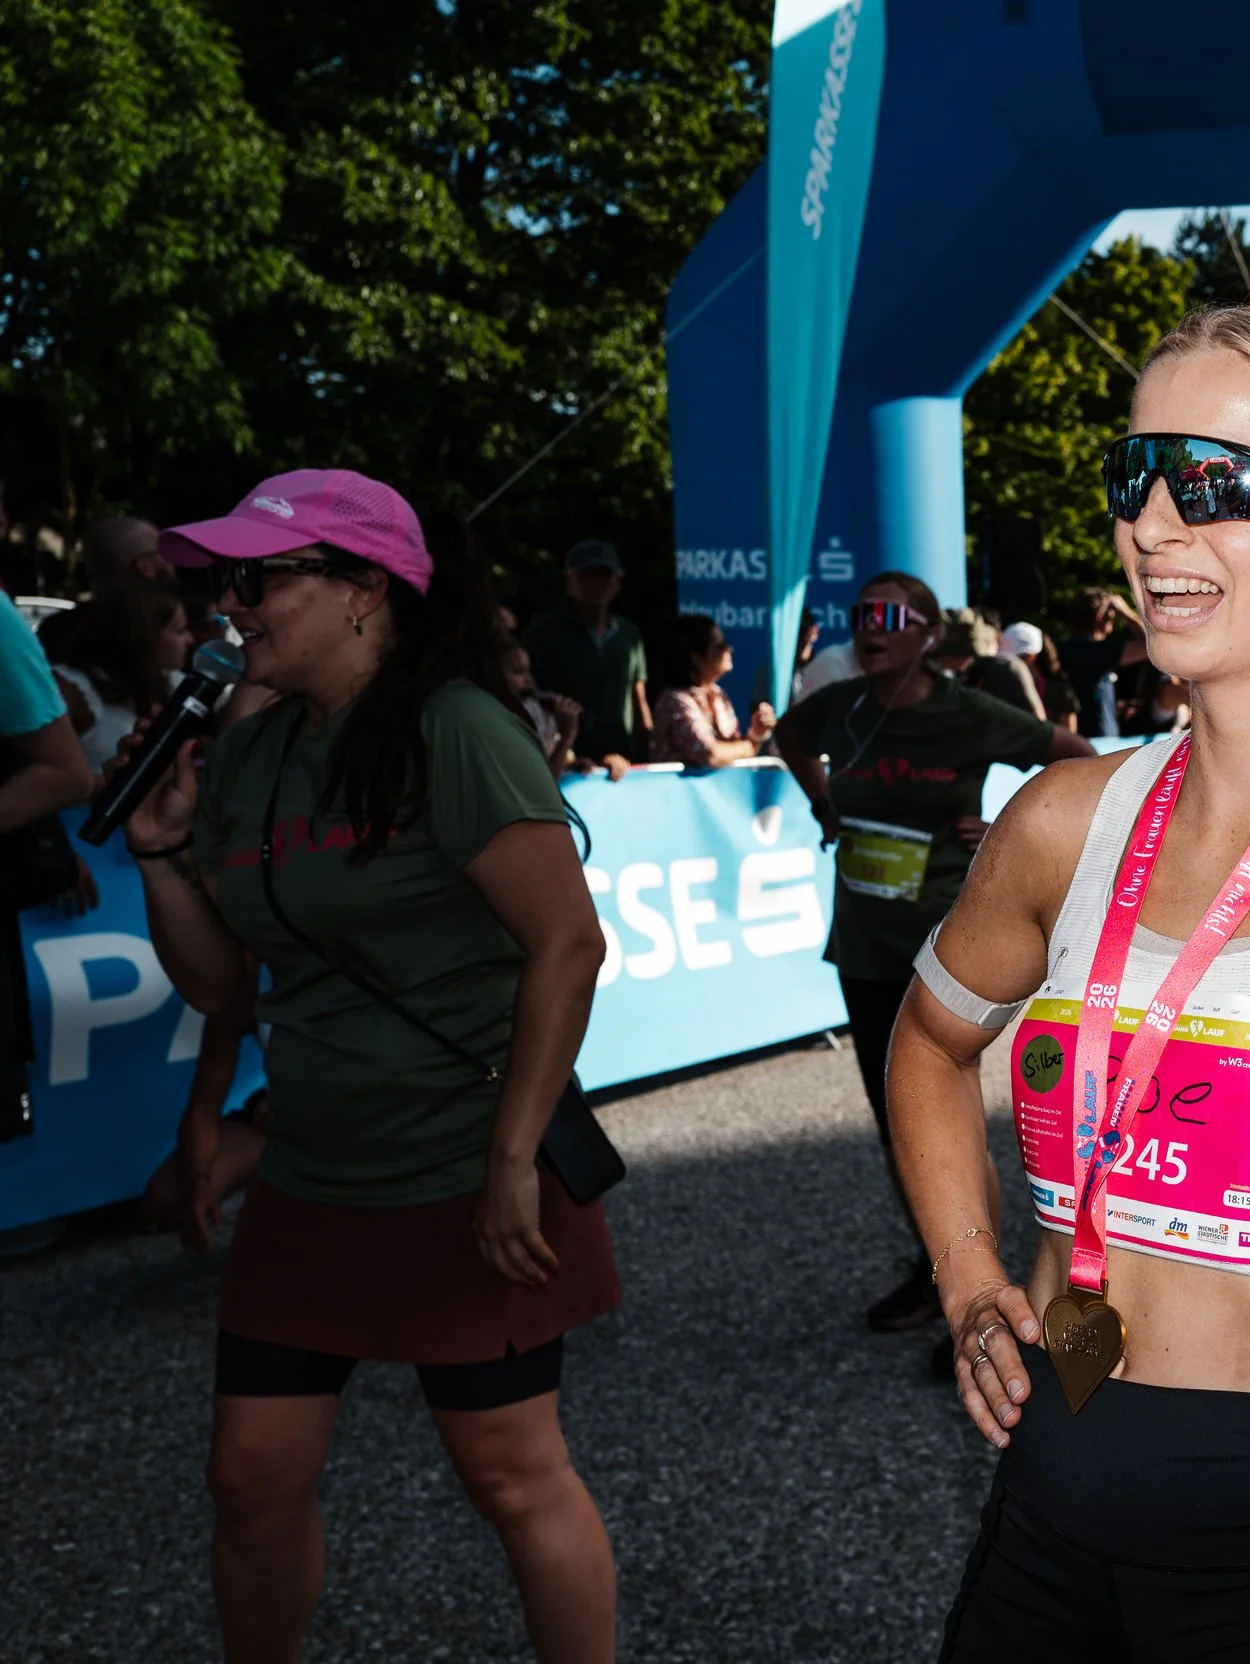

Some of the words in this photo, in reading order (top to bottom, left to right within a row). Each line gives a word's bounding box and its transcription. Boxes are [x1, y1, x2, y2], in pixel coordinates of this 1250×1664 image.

[1116, 864, 1146, 907] Ohne
[1133, 805, 1168, 858] Frauen
[1087, 983, 1103, 1008] 20
[1100, 984, 1118, 1009] 26
[1118, 1016, 1140, 1026] LAUF
[1202, 1027, 1226, 1037] LAUF
[1023, 1051, 1065, 1078] Silber
[1218, 1057, 1228, 1068] by
[1228, 1056, 1243, 1068] W3
[1083, 1070, 1098, 1124] LAUF
[1109, 1076, 1133, 1127] FRAUEN
[1113, 1212, 1157, 1227] INTERSPORT
[1168, 1217, 1188, 1233] dm
[1197, 1225, 1219, 1235] WIENER
